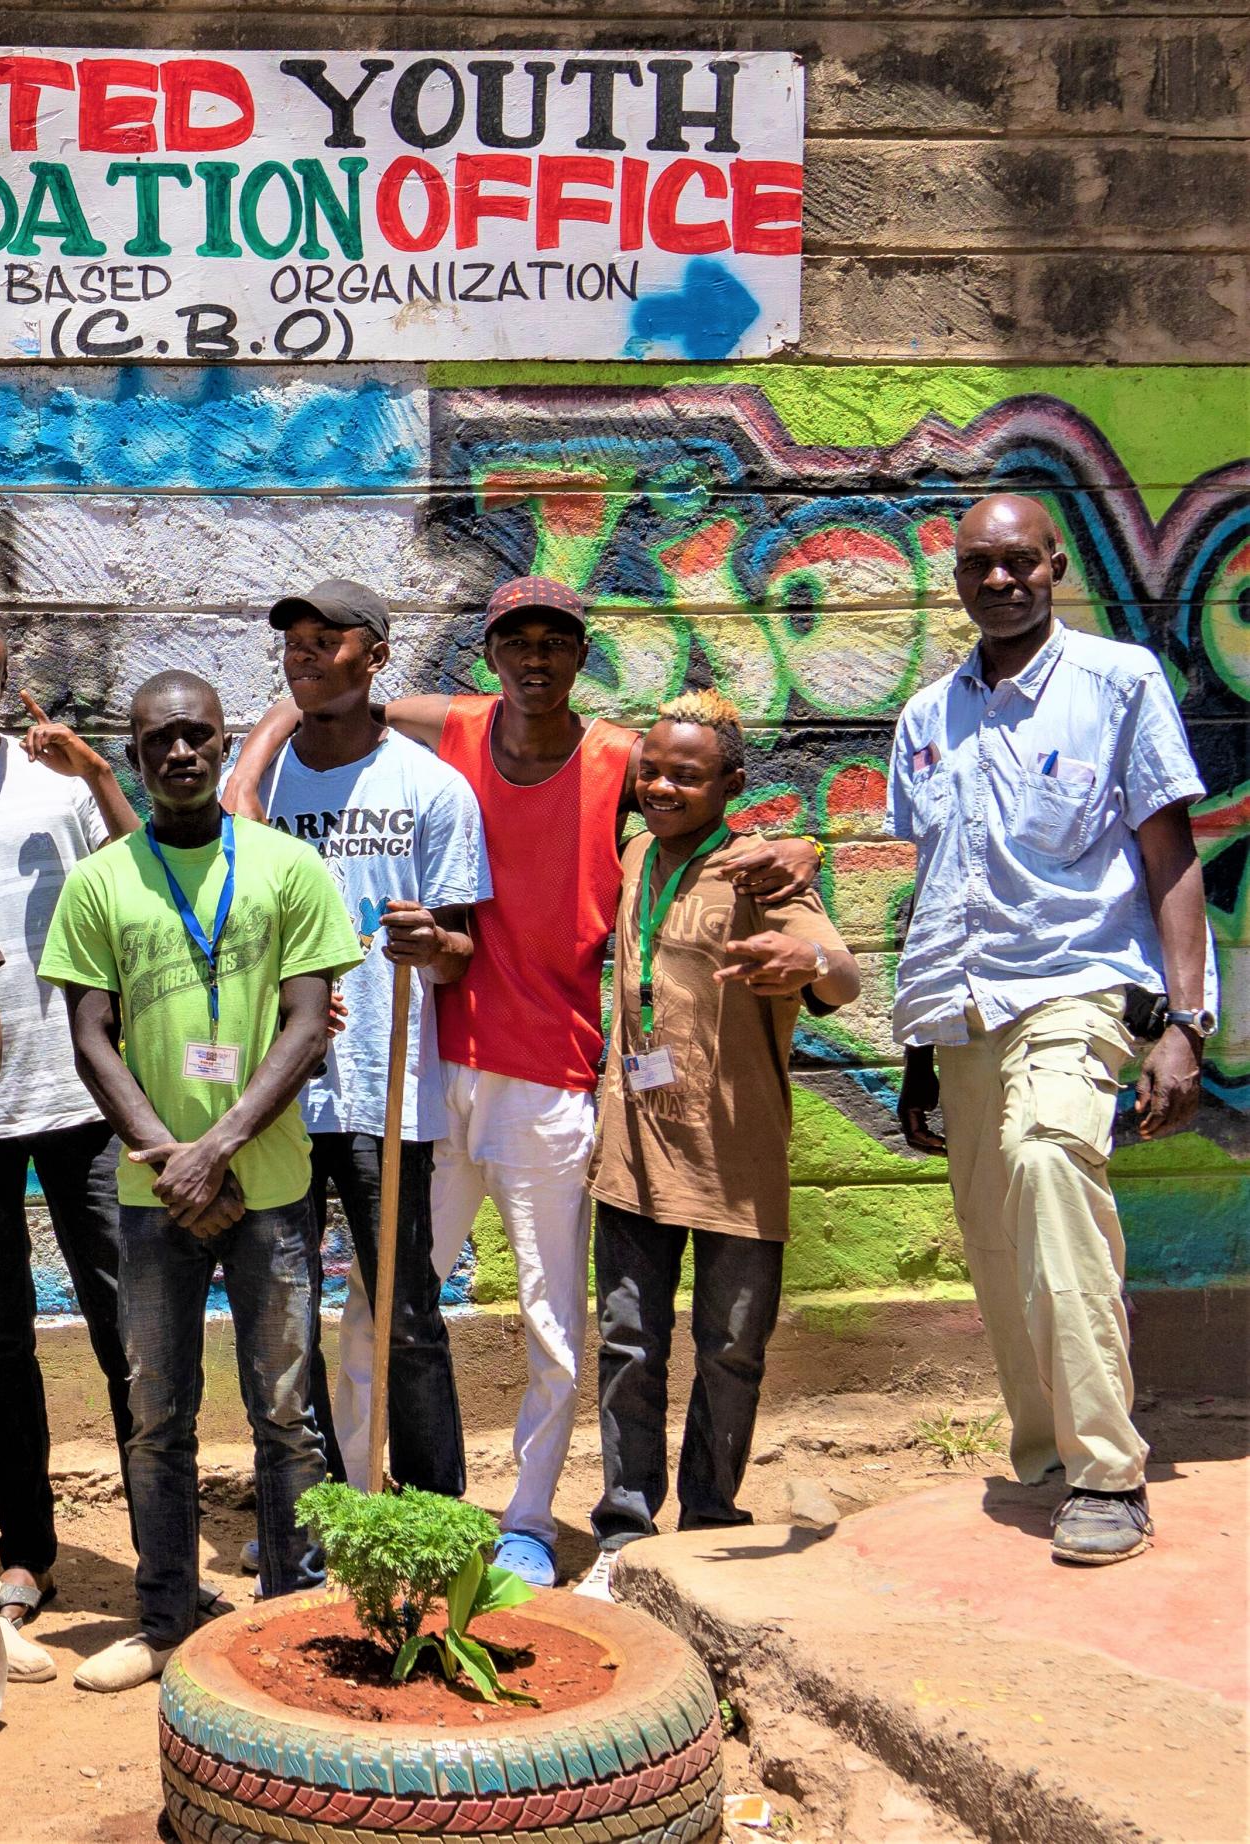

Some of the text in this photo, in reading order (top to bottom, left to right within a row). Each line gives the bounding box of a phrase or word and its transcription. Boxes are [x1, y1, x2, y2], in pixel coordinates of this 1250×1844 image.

[280, 58, 740, 152] YOUTH
[377, 154, 803, 255] OFFICE
[5, 264, 171, 304] BASED
[271, 261, 638, 304] ORGANIZATION
[50, 304, 354, 361] (C.B.O)
[267, 807, 415, 840] ARNING
[318, 837, 412, 859] ANCING!
